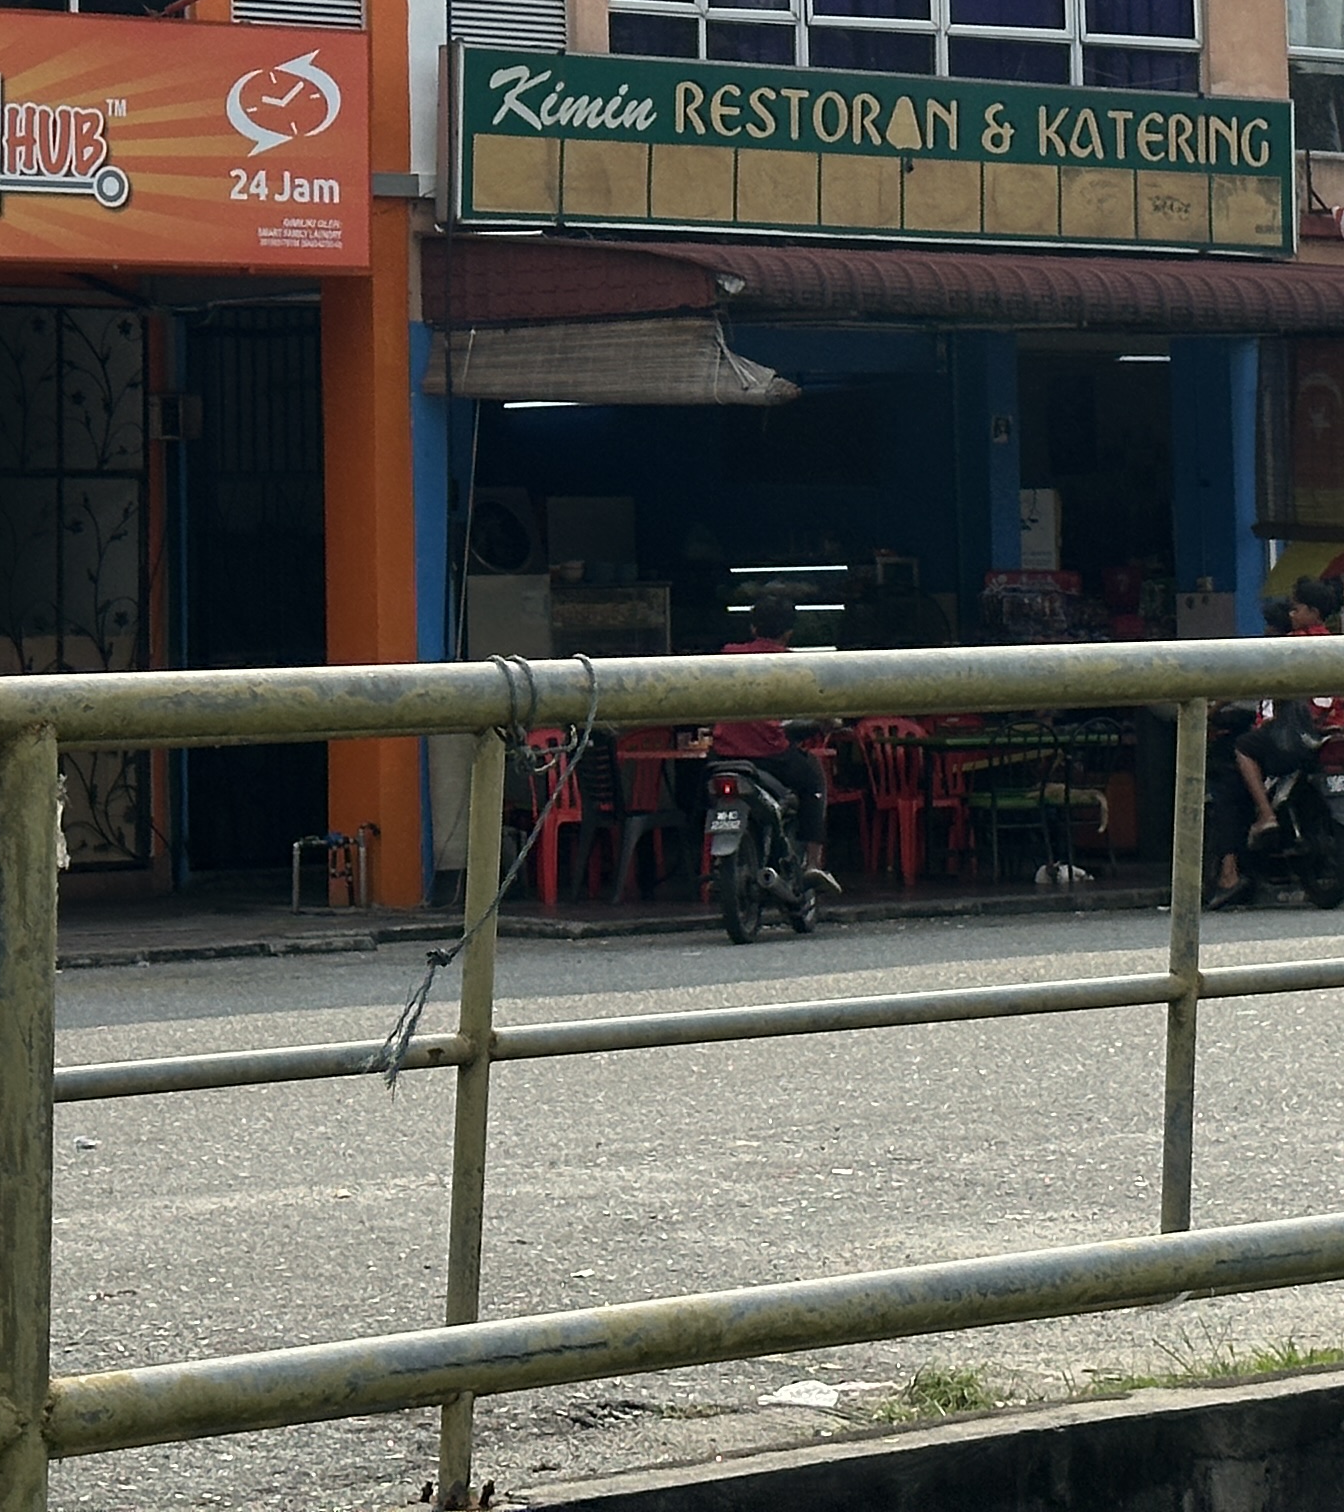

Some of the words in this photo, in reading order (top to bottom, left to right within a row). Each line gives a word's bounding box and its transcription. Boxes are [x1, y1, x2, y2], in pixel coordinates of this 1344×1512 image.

[3, 101, 107, 177] HUB
[106, 99, 127, 118] TM
[490, 65, 656, 131] Kimin
[675, 81, 957, 151] RESTORAN
[982, 102, 1014, 154] &
[1038, 105, 1269, 167] KATERING
[229, 168, 268, 201] 24
[274, 171, 340, 204] Jam
